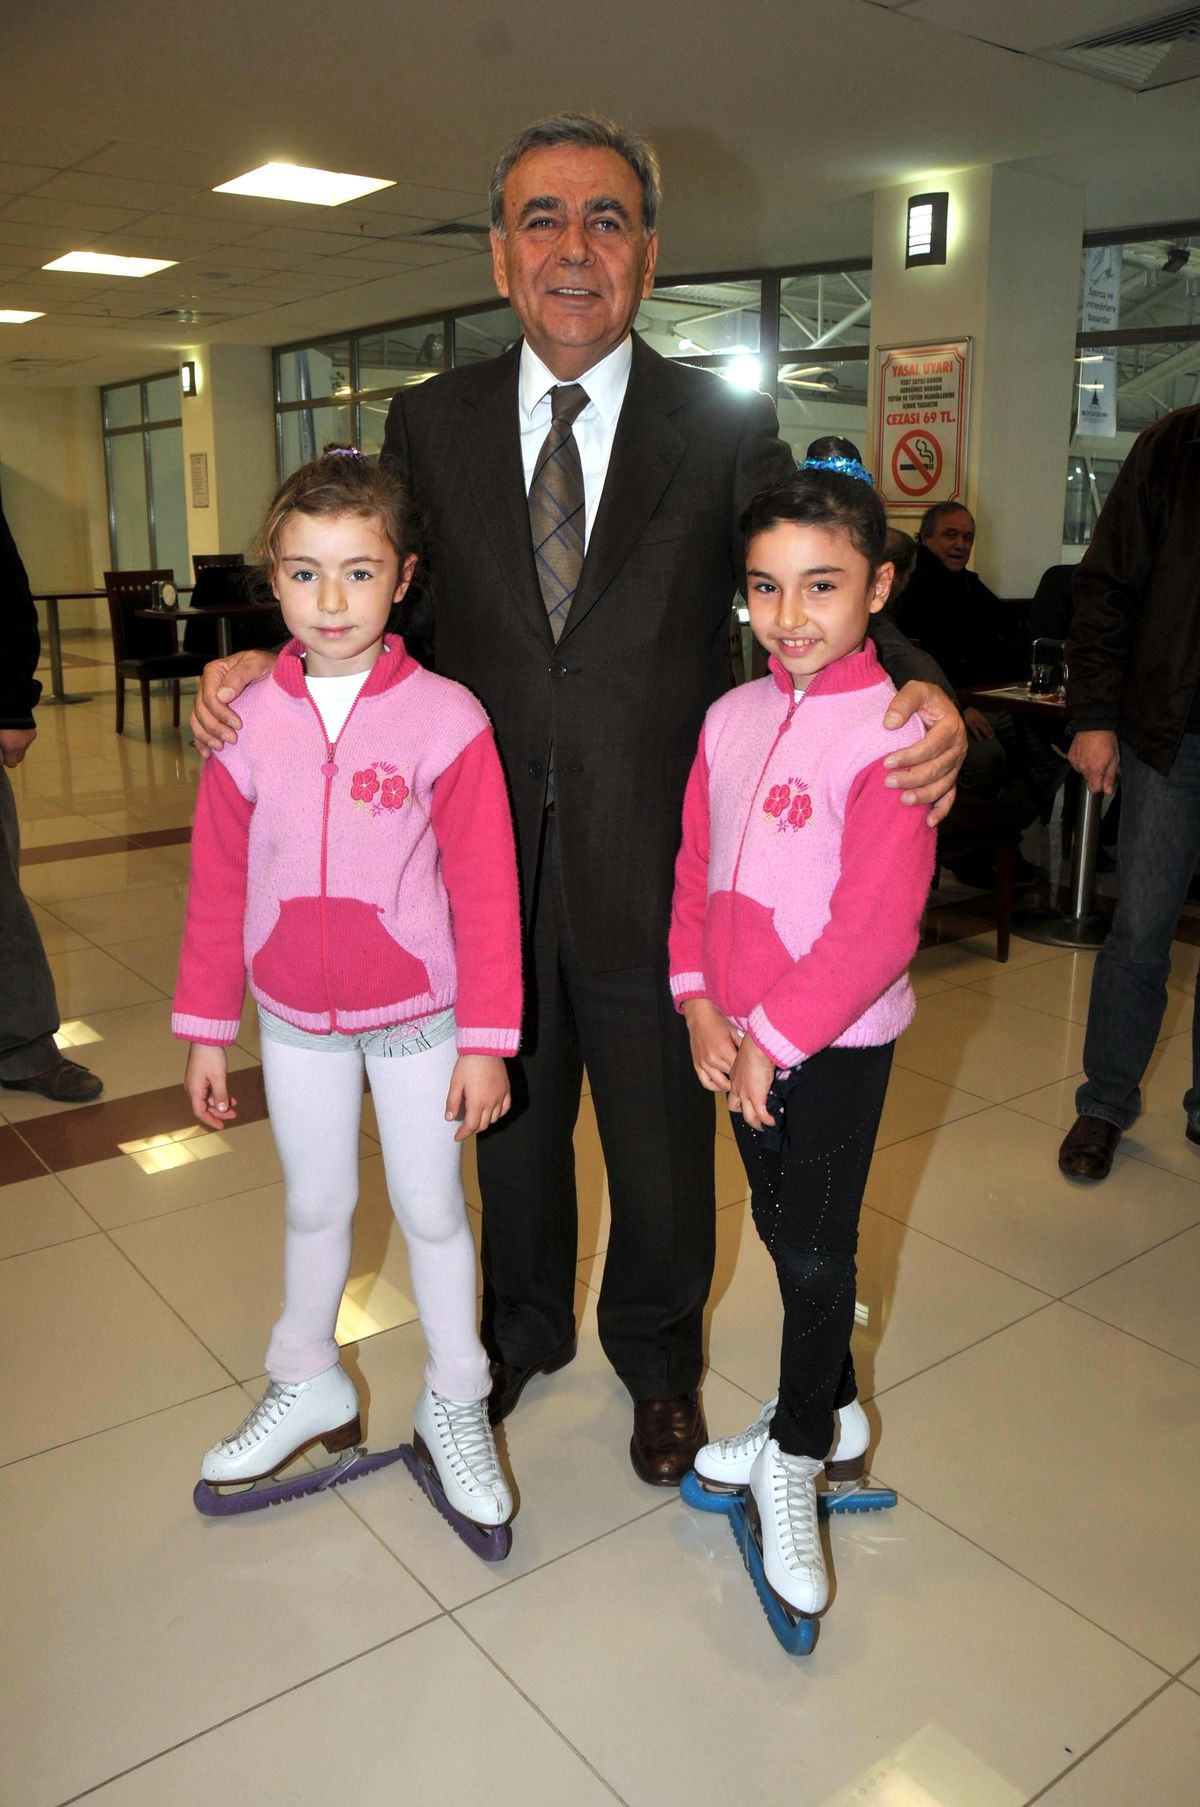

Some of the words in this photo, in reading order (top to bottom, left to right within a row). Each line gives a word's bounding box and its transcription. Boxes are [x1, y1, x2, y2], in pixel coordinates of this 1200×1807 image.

[892, 365, 919, 377] YASAL
[923, 361, 953, 374] UYARI
[923, 411, 937, 424] 69
[940, 411, 956, 423] TL.
